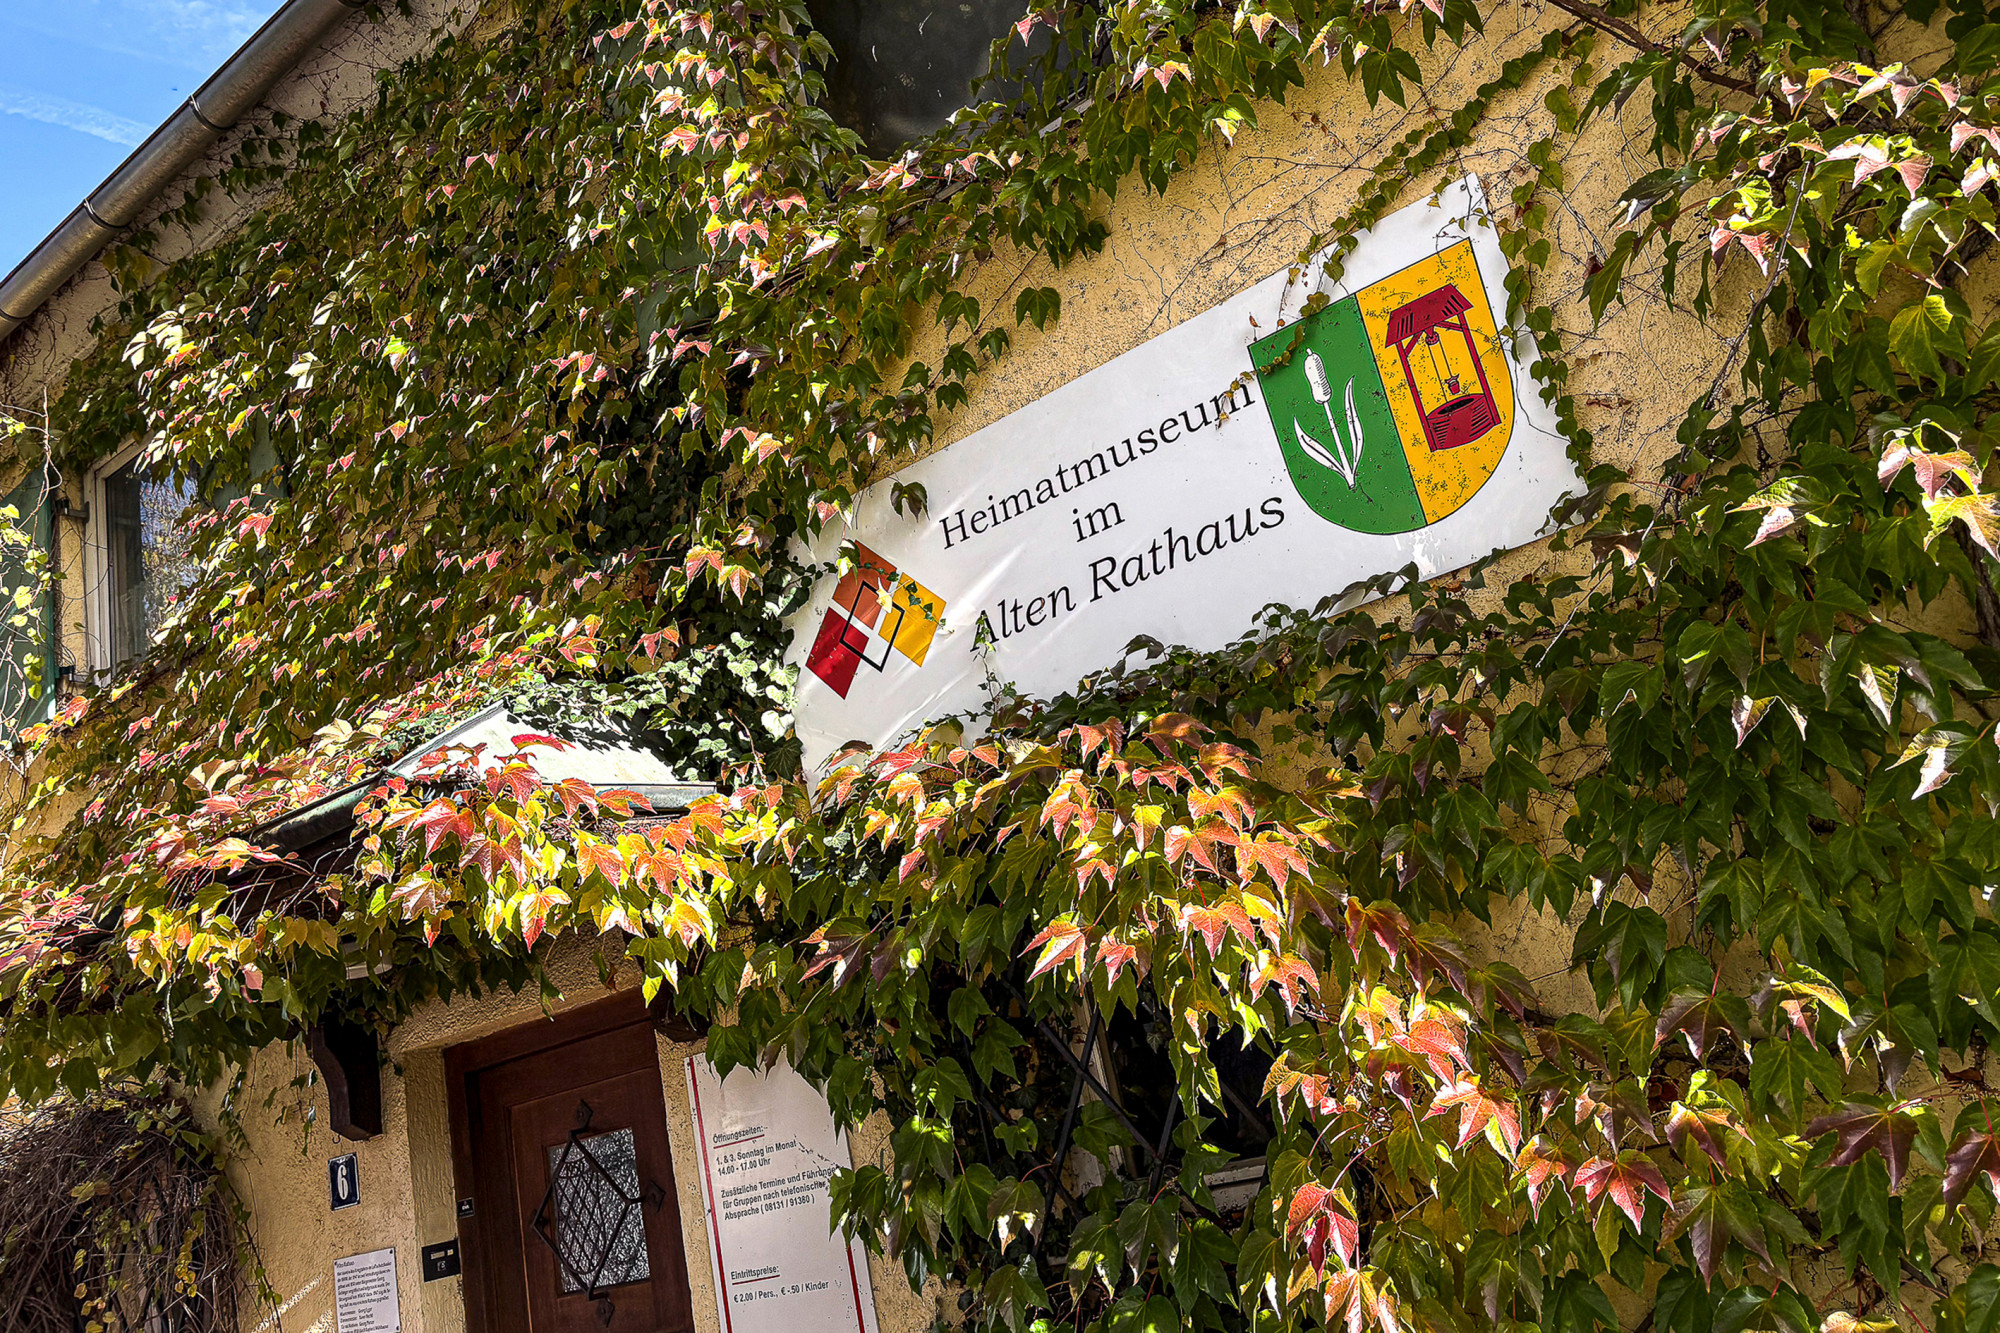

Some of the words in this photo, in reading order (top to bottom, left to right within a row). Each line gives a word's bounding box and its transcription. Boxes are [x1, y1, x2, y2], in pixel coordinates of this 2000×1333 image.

[939, 383, 1256, 550] Heimatmuseum
[1072, 502, 1126, 543] im
[970, 586, 1077, 653] Alten
[1088, 496, 1286, 603] Rathaus
[713, 1126, 763, 1144] Öffnungszeiten:
[716, 1156, 723, 1166] 1.
[723, 1155, 729, 1164] &
[729, 1153, 736, 1163] 3.
[737, 1147, 765, 1161] Sonntag
[765, 1145, 774, 1153] im
[775, 1139, 796, 1152] Monat
[718, 1165, 735, 1177] 14.00
[740, 1160, 757, 1171] 17.00
[758, 1157, 771, 1167] Uhr
[337, 1164, 349, 1200] 6
[721, 1183, 758, 1199] Zusätzliche
[758, 1177, 786, 1190] Termine
[787, 1173, 801, 1184] und
[802, 1166, 837, 1180] Führunge
[722, 1199, 732, 1210] für
[733, 1194, 762, 1209] Gruppen
[763, 1191, 780, 1202] nach
[724, 1206, 759, 1221] Absprache
[764, 1201, 784, 1212] 08131
[730, 1265, 780, 1281] Eintrittspreise:
[733, 1294, 739, 1303] €
[739, 1292, 753, 1303] 2.00
[780, 1286, 786, 1296] €
[805, 1280, 829, 1292] Kinder
